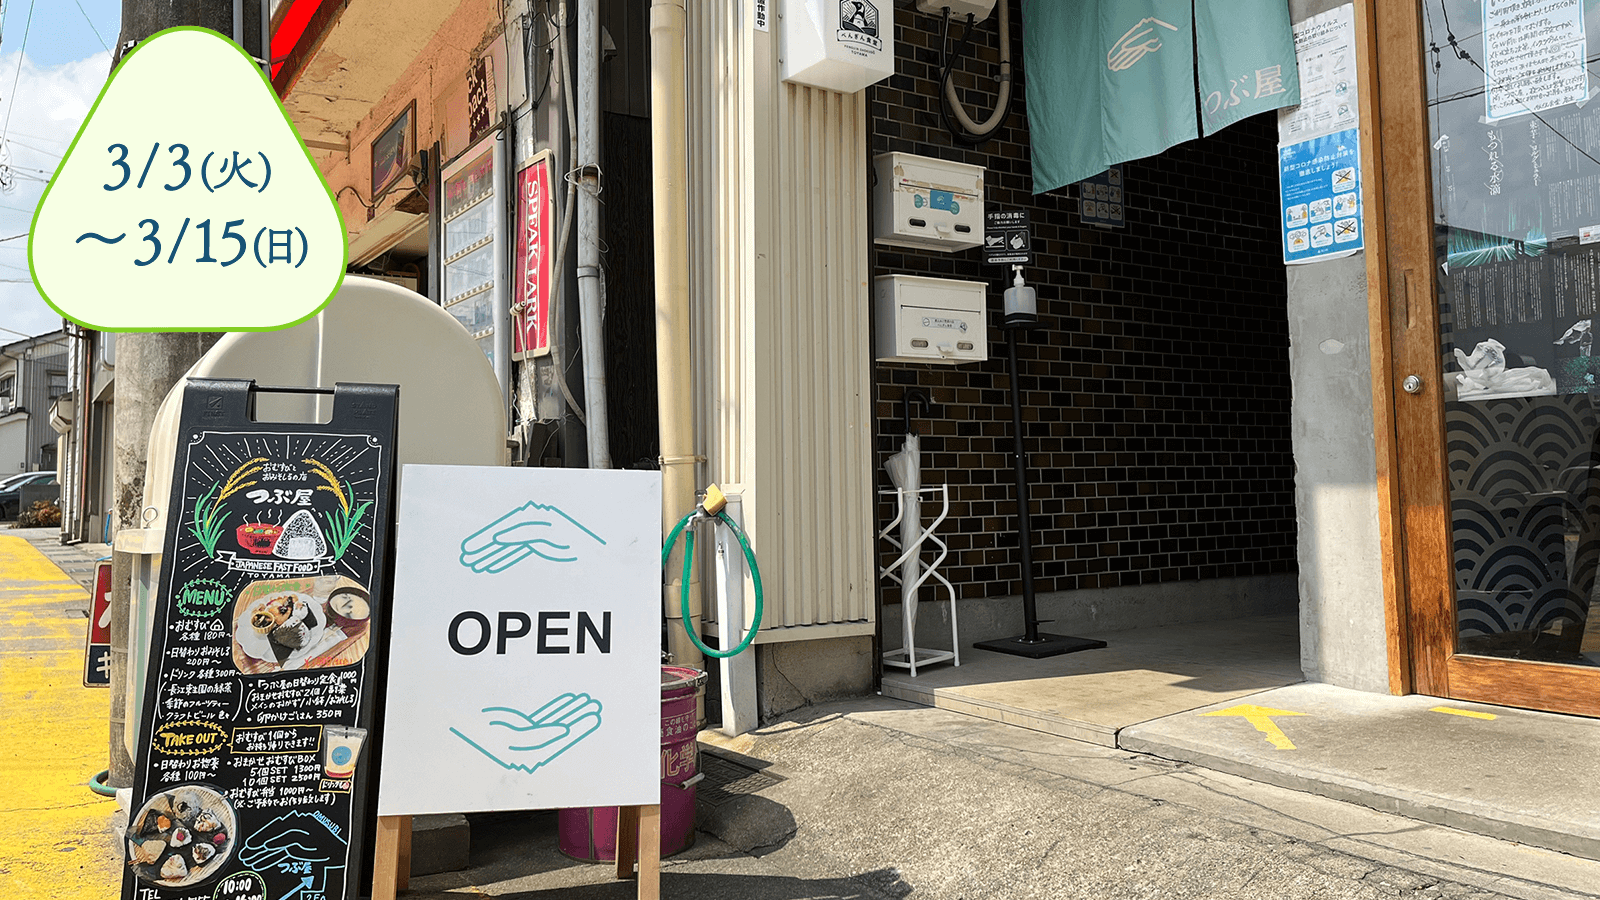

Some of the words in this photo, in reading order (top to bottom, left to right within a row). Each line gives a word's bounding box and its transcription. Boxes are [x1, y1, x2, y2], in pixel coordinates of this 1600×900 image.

[1204, 64, 1286, 116] つぶ屋
[1487, 130, 1501, 195] もつれる水滴
[246, 489, 314, 506] つぶ屋
[235, 560, 273, 571] JAPANESE
[273, 562, 292, 573] FAST
[293, 563, 313, 572] FOOD
[183, 589, 225, 606] MENU
[175, 619, 210, 633] おむすび
[448, 611, 612, 655] OPEN
[169, 668, 196, 681] ドリンク
[165, 698, 230, 710] 季節のフルーツティー
[166, 711, 216, 721] クラフトビール
[316, 710, 342, 719] 350円
[160, 732, 195, 748] TAKE
[195, 732, 218, 744] OUT
[294, 764, 321, 774] 1300円
[291, 773, 321, 782] 2500円
[313, 811, 342, 835] OMUSUBI
[278, 862, 313, 875] つぶ屋
[223, 878, 252, 894] 10:00
[139, 888, 161, 900] TEL
